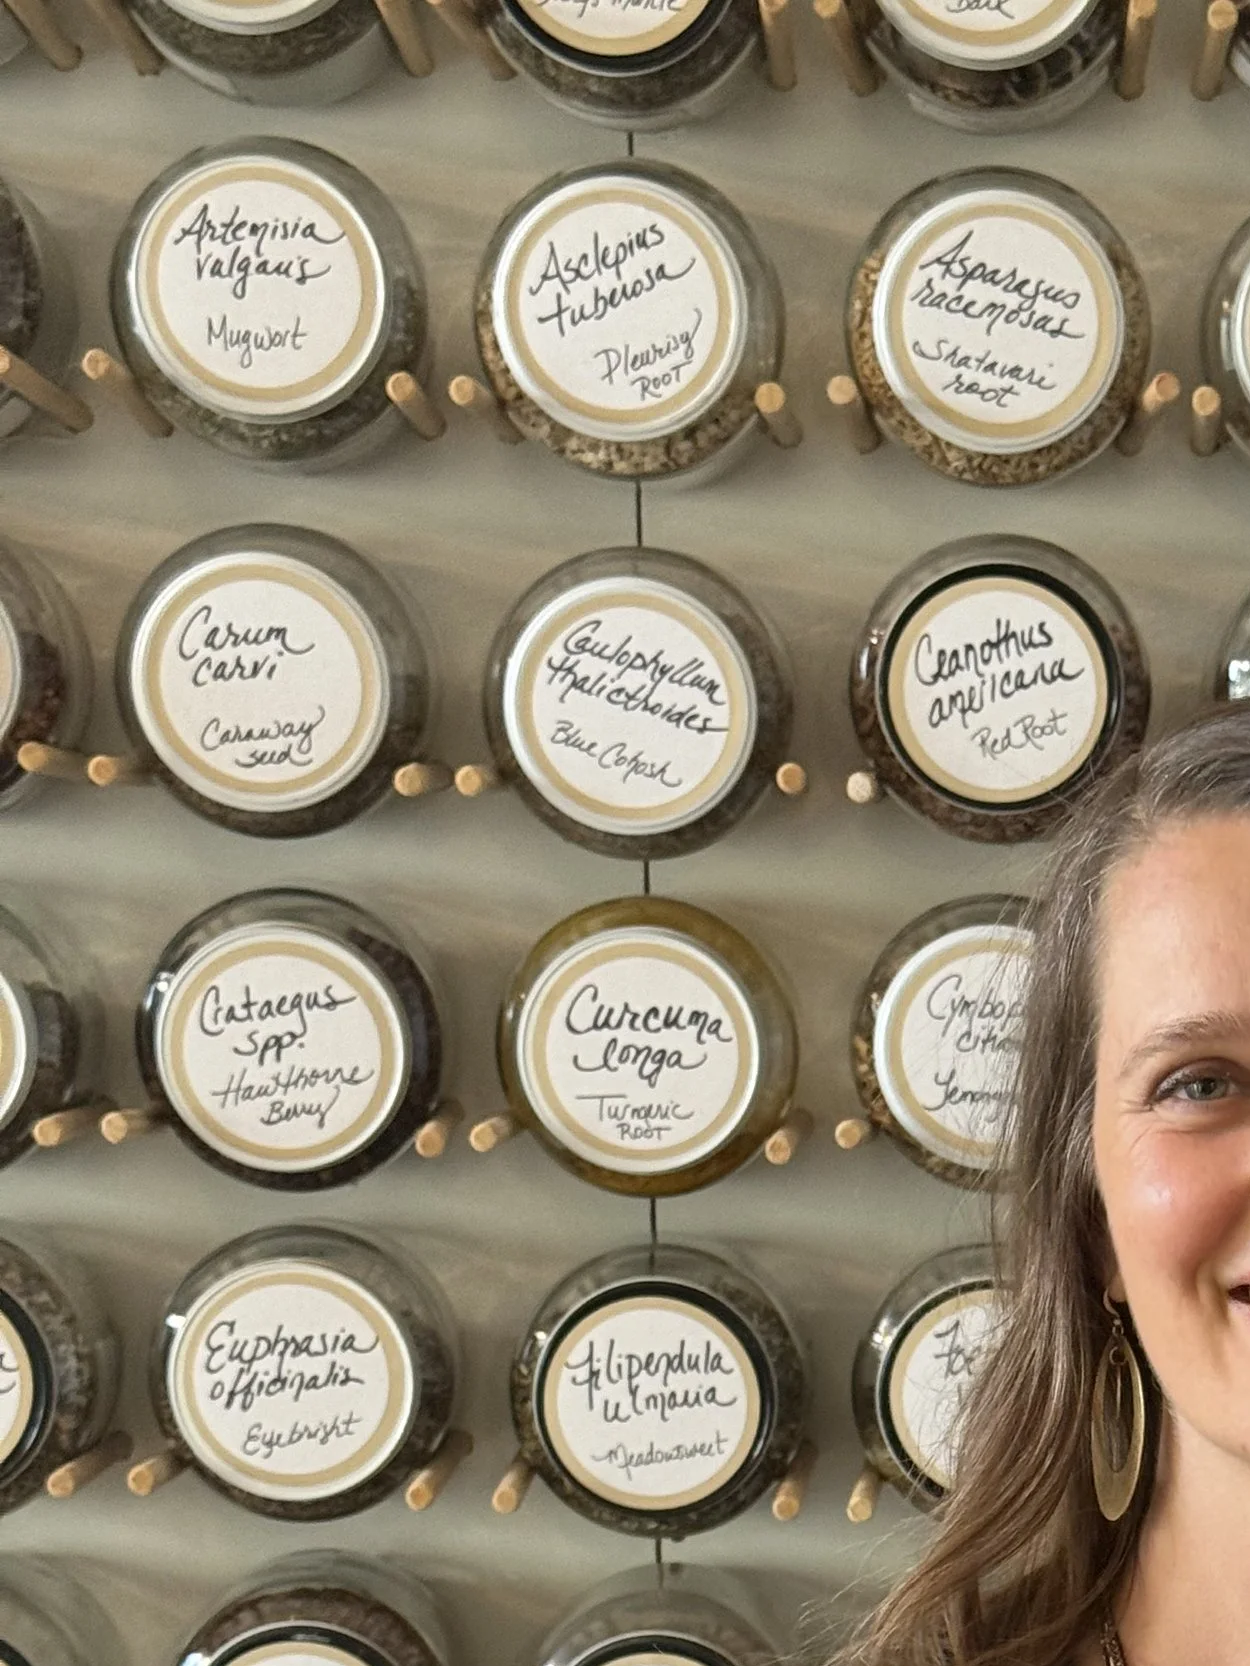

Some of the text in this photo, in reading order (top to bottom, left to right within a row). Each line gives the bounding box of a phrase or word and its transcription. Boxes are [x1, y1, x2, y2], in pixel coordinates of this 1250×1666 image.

[174, 203, 346, 256] Artemisia
[528, 223, 666, 296] Asclepius
[207, 314, 307, 368] Mugwort
[551, 719, 599, 758] Blue
[199, 985, 356, 1036] Crataegus
[565, 985, 733, 1043] Curcuma
[205, 1320, 380, 1375] Euphrasia
